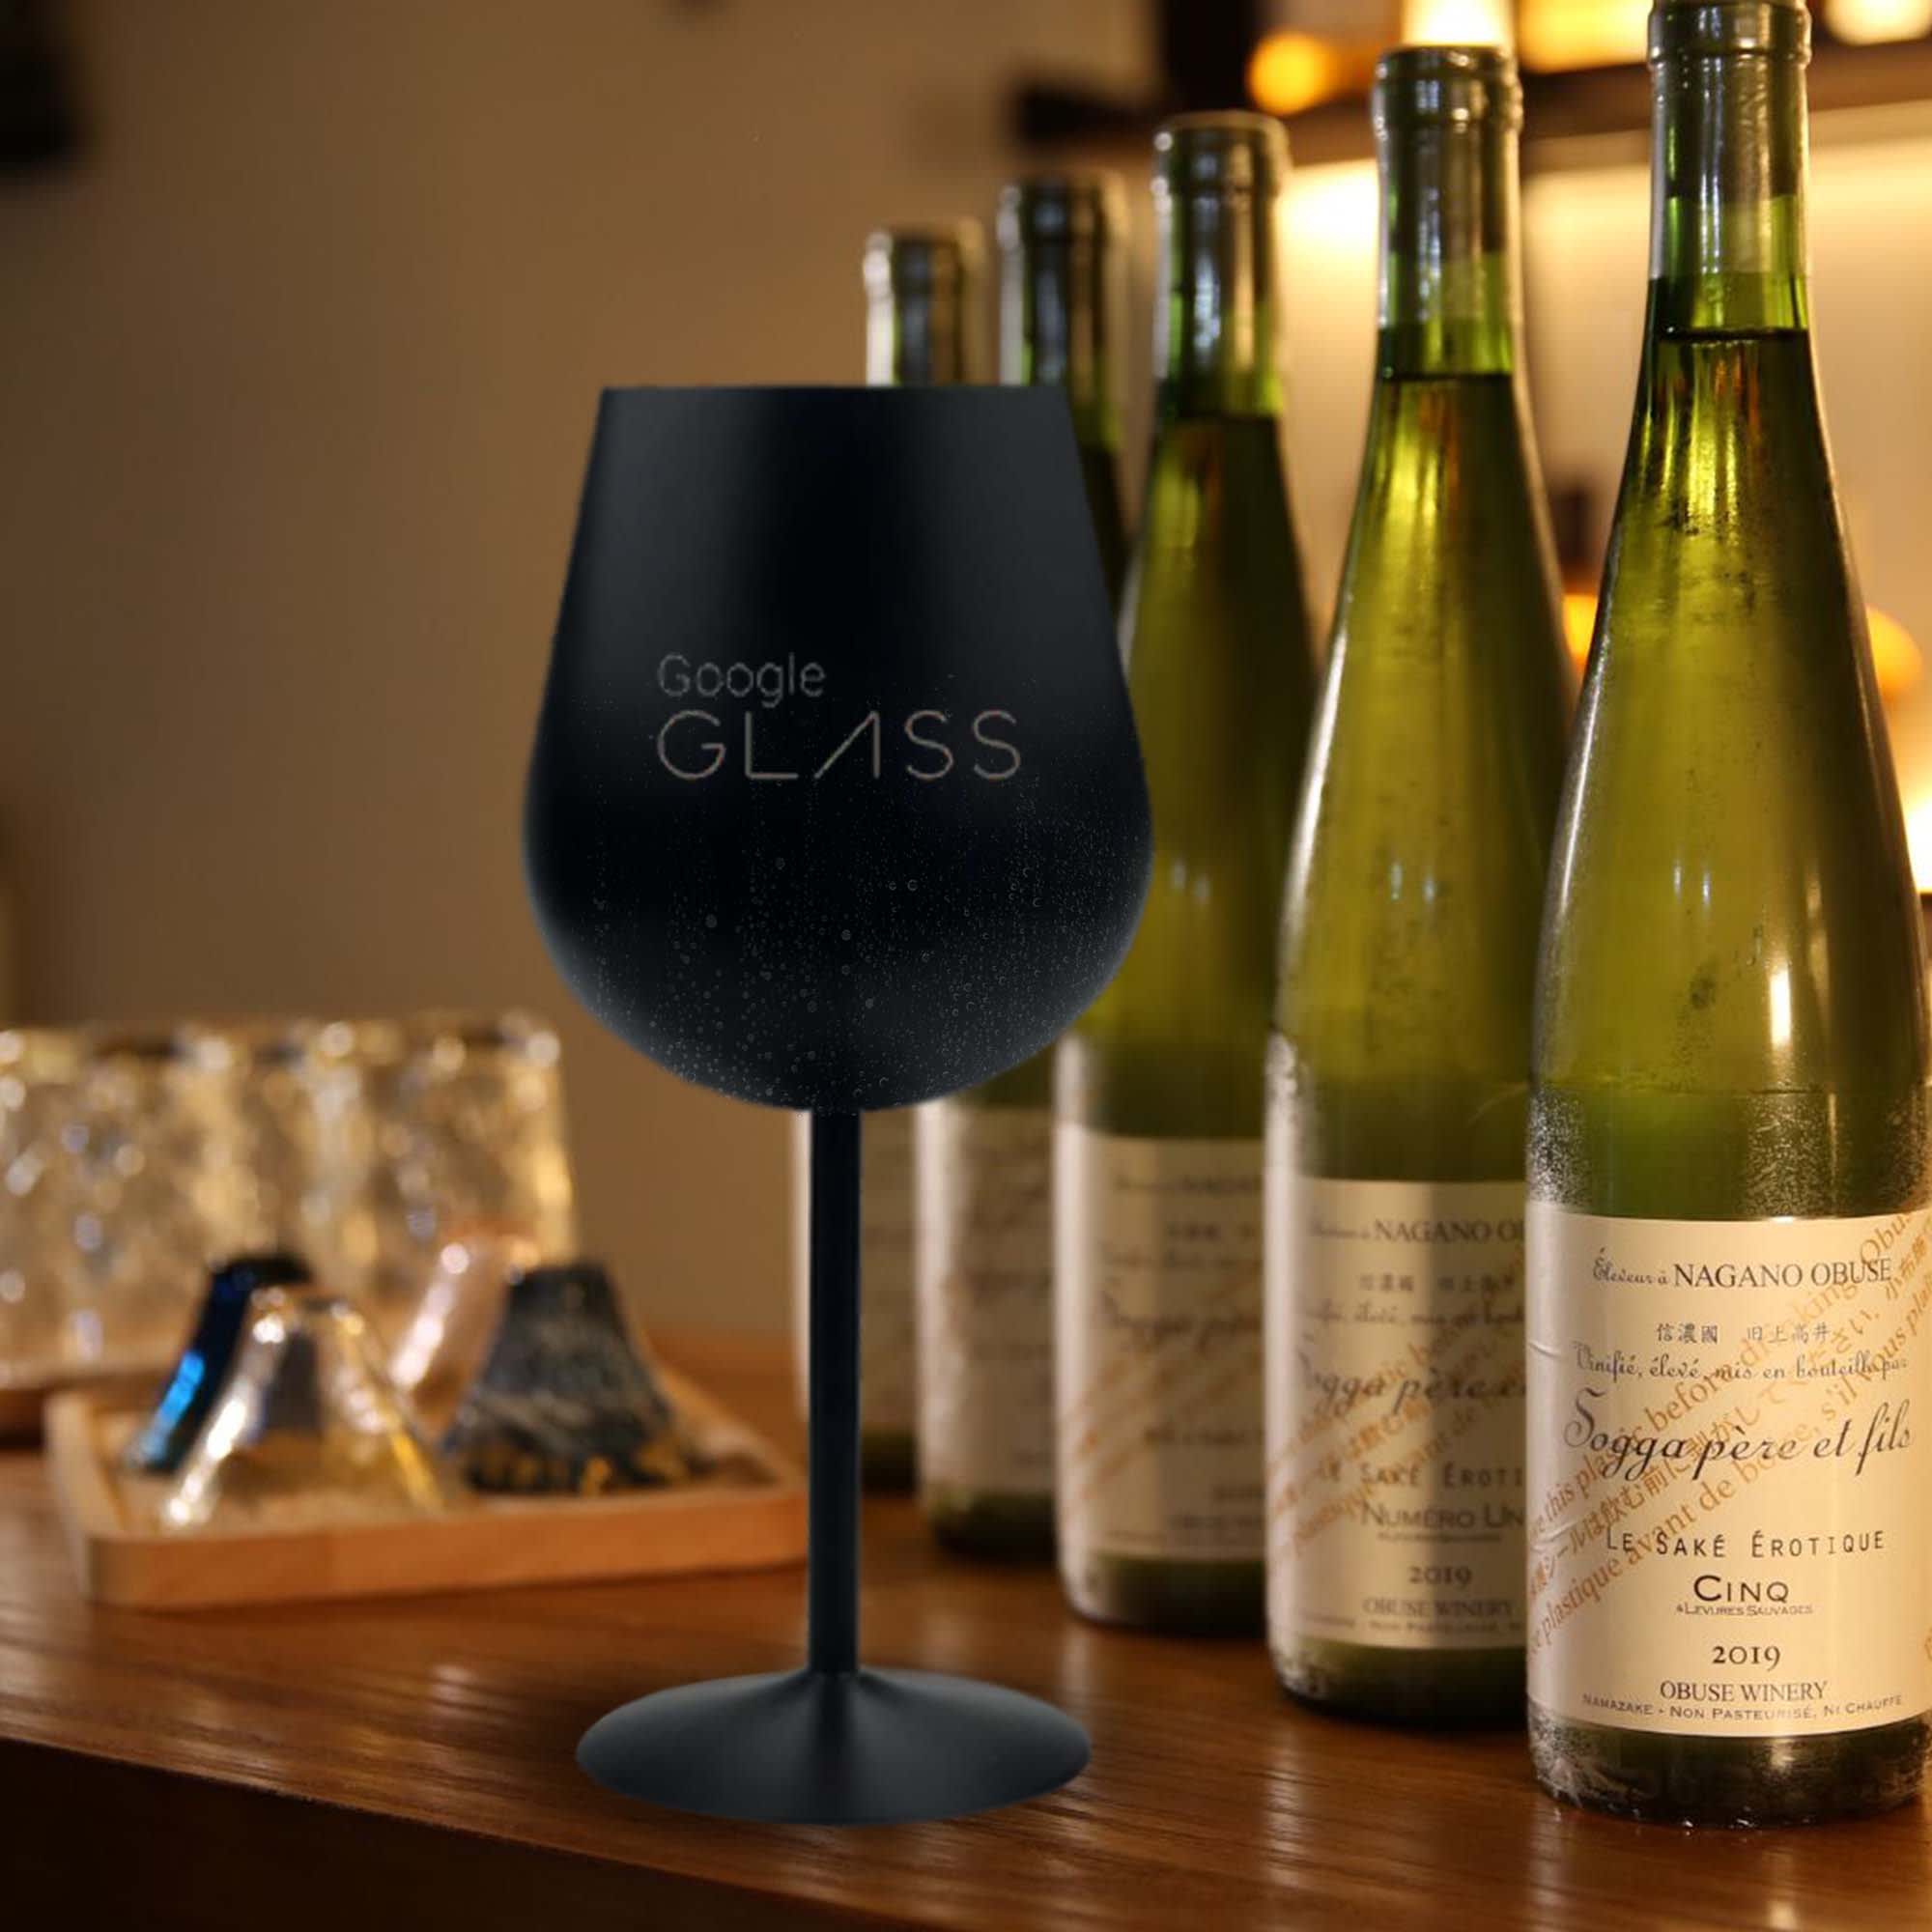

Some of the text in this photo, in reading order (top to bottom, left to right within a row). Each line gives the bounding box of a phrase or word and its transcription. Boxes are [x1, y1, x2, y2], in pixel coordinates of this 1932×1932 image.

[657, 652, 826, 708] Google
[657, 709, 1021, 781] GLASS
[1375, 1219, 1492, 1243] NAGANO
[1673, 1263, 1803, 1288] NAGANO
[1810, 1257, 1892, 1287] OBUSE
[1563, 1387, 1689, 1482] Sogga
[1690, 1425, 1801, 1482] père
[1813, 1418, 1856, 1458] et
[1857, 1398, 1913, 1477] fils
[1576, 1424, 1643, 1500] plasic
[1626, 1502, 1697, 1567] avant
[1699, 1478, 1736, 1511] de
[1407, 1564, 1473, 1588] 2019
[1711, 1644, 1781, 1672] 2019
[1659, 1679, 1829, 1703] OBUSE WINERY
